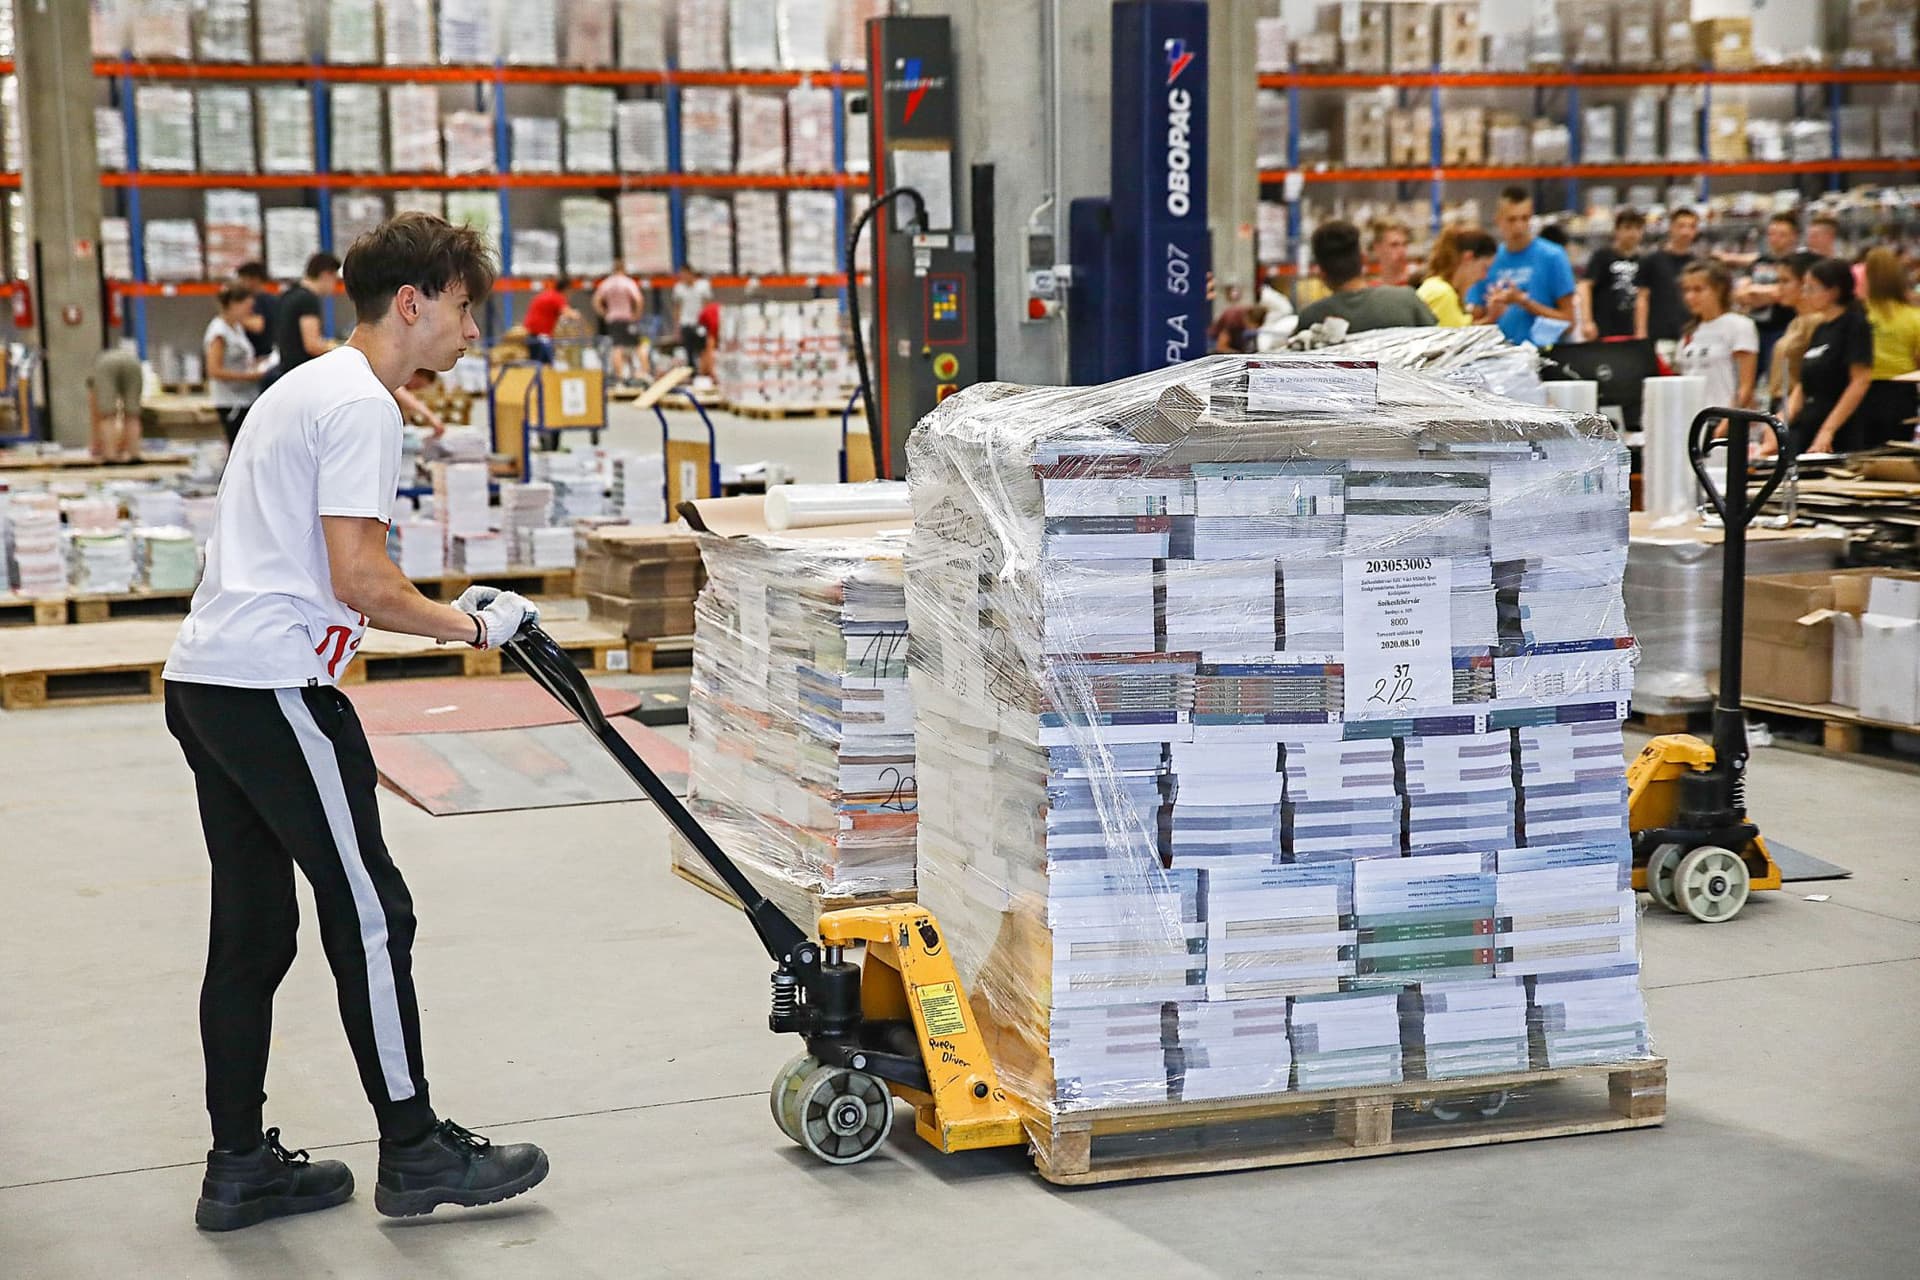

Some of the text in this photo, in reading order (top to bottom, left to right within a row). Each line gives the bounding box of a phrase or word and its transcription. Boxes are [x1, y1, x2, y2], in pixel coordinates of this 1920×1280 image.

[1167, 88, 1192, 217] OBOPAC
[1167, 243, 1190, 295] 507
[1366, 557, 1432, 573] 203053003
[1390, 618, 1408, 627] 8000
[1381, 639, 1420, 649] 2020.08.10
[1393, 664, 1410, 678] 37
[1367, 677, 1417, 705] 2/2
